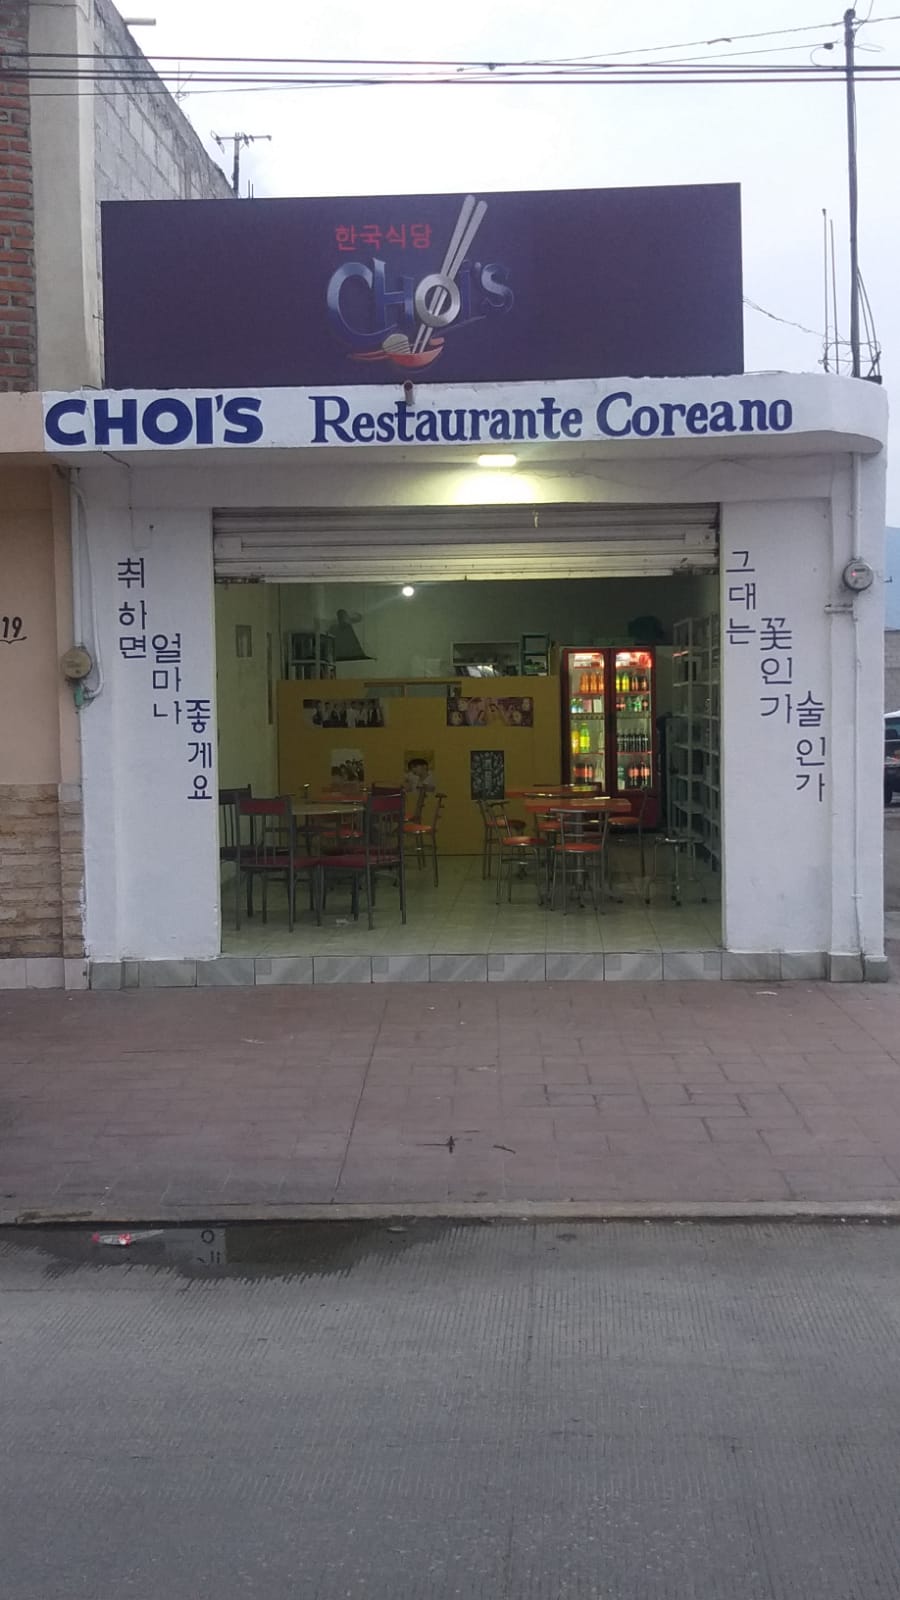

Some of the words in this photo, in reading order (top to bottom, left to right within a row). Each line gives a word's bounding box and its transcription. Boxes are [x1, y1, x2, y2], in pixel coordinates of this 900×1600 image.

[335, 224, 432, 251] 한국식당
[45, 394, 264, 446] CHOI'S
[308, 394, 583, 444] Restaurante
[596, 391, 793, 437] Coreano
[2, 616, 22, 638] 19
[117, 557, 147, 659] 취하면
[725, 550, 757, 645] 그대는
[151, 633, 182, 725] 얼마나
[759, 617, 793, 724] 꽃인가
[185, 699, 213, 800] 좋게요
[795, 690, 826, 802] 술인가
